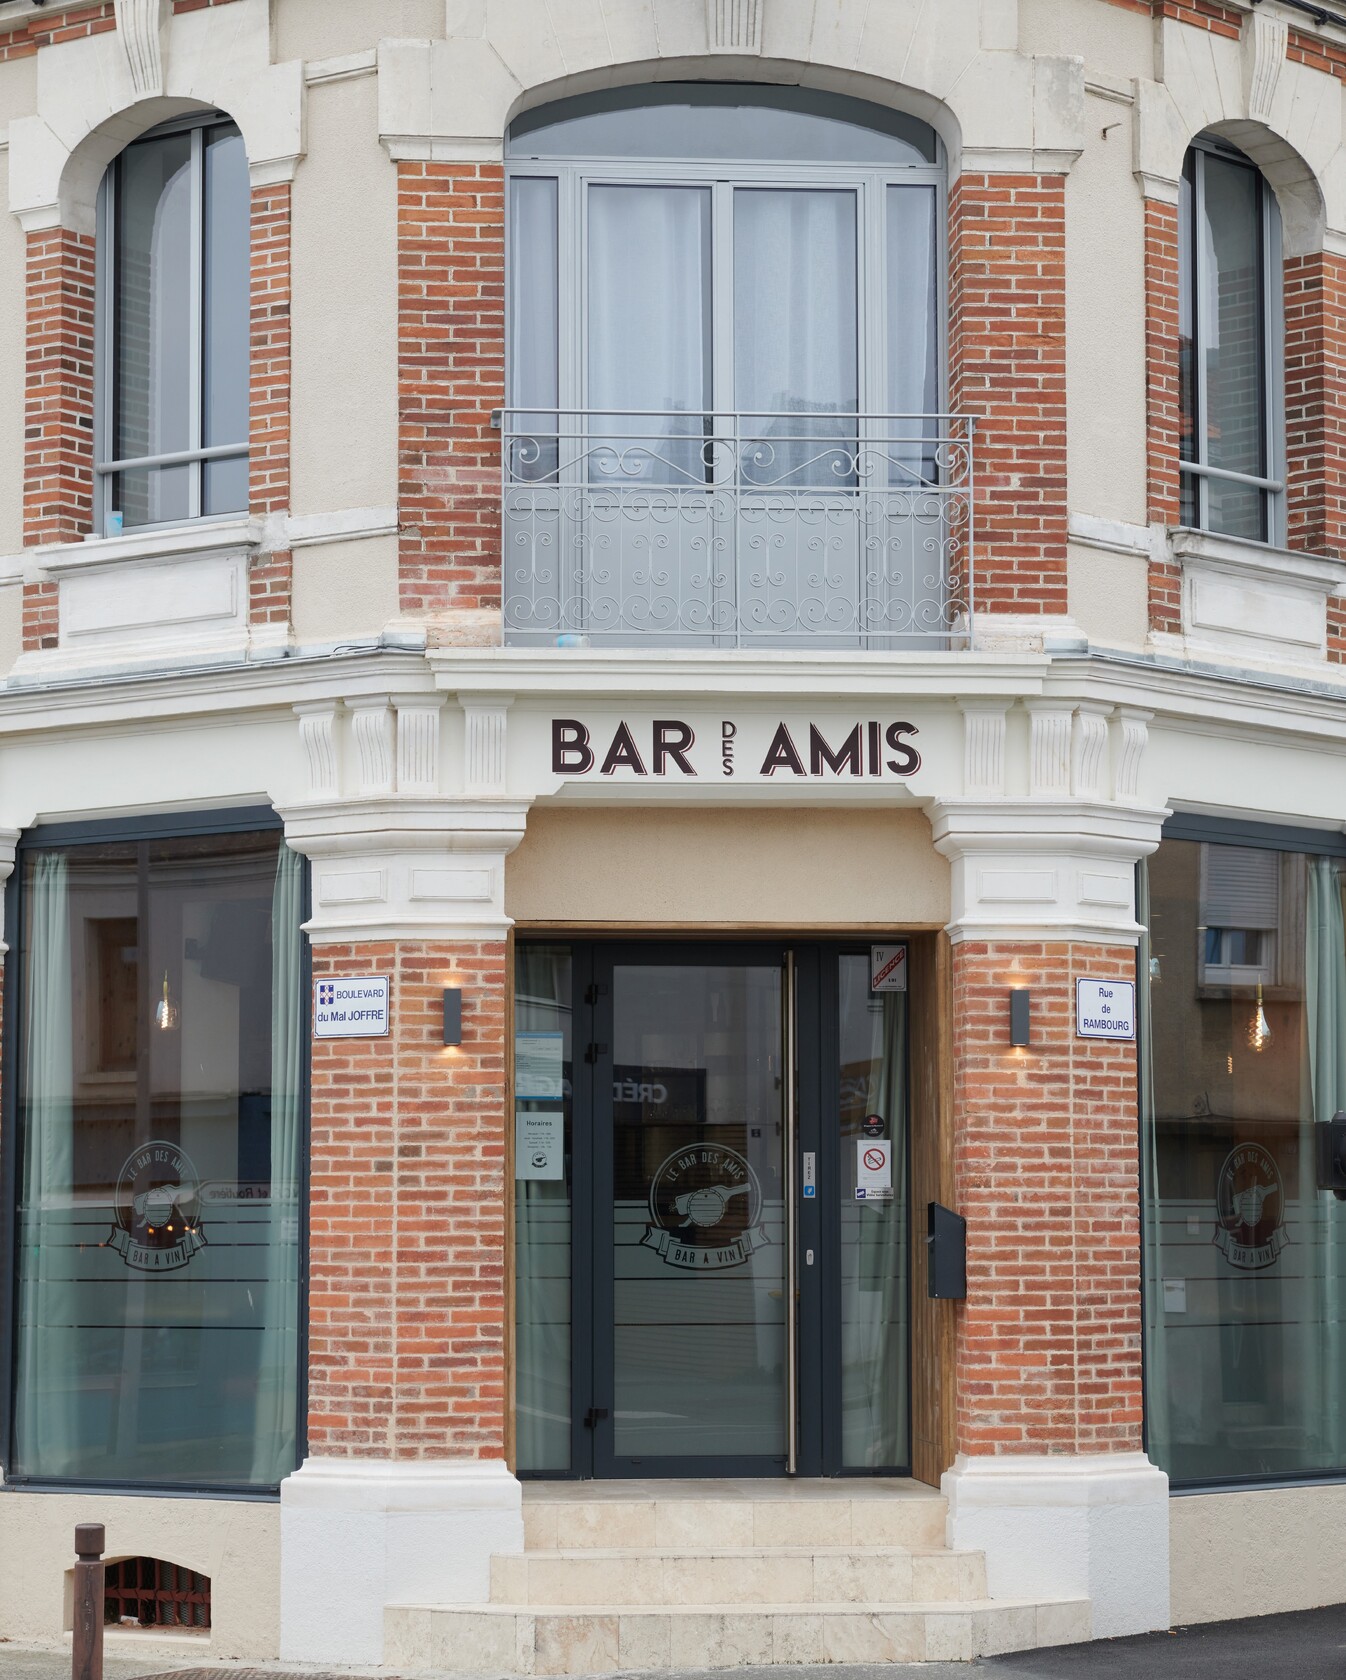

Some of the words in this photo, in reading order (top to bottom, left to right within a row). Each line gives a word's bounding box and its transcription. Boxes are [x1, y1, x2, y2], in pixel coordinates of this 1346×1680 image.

[551, 719, 698, 775] BAR
[722, 721, 737, 776] DES
[759, 721, 922, 777] AMIS
[876, 951, 884, 962] IV
[336, 989, 385, 1000] BOULEVARD
[1098, 987, 1114, 998] Rue
[317, 1012, 329, 1022] du
[331, 1011, 347, 1022] Mal
[348, 1009, 384, 1021] JOFFRE
[1101, 1004, 1111, 1014] de
[1083, 1018, 1130, 1031] RAMBOURG
[127, 1168, 138, 1181] LE
[136, 1153, 151, 1169] BAR
[155, 1150, 169, 1162] DES
[171, 1159, 190, 1179] AMIS
[666, 1168, 679, 1182] LE
[678, 1154, 697, 1170] BAR
[701, 1151, 719, 1164] DES
[722, 1158, 744, 1180] AMIS
[132, 1250, 148, 1265] BAR
[154, 1255, 159, 1265] A
[165, 1251, 181, 1264] VIN
[675, 1249, 695, 1263] BAR
[703, 1253, 709, 1264] A
[716, 1249, 736, 1263] VIN
